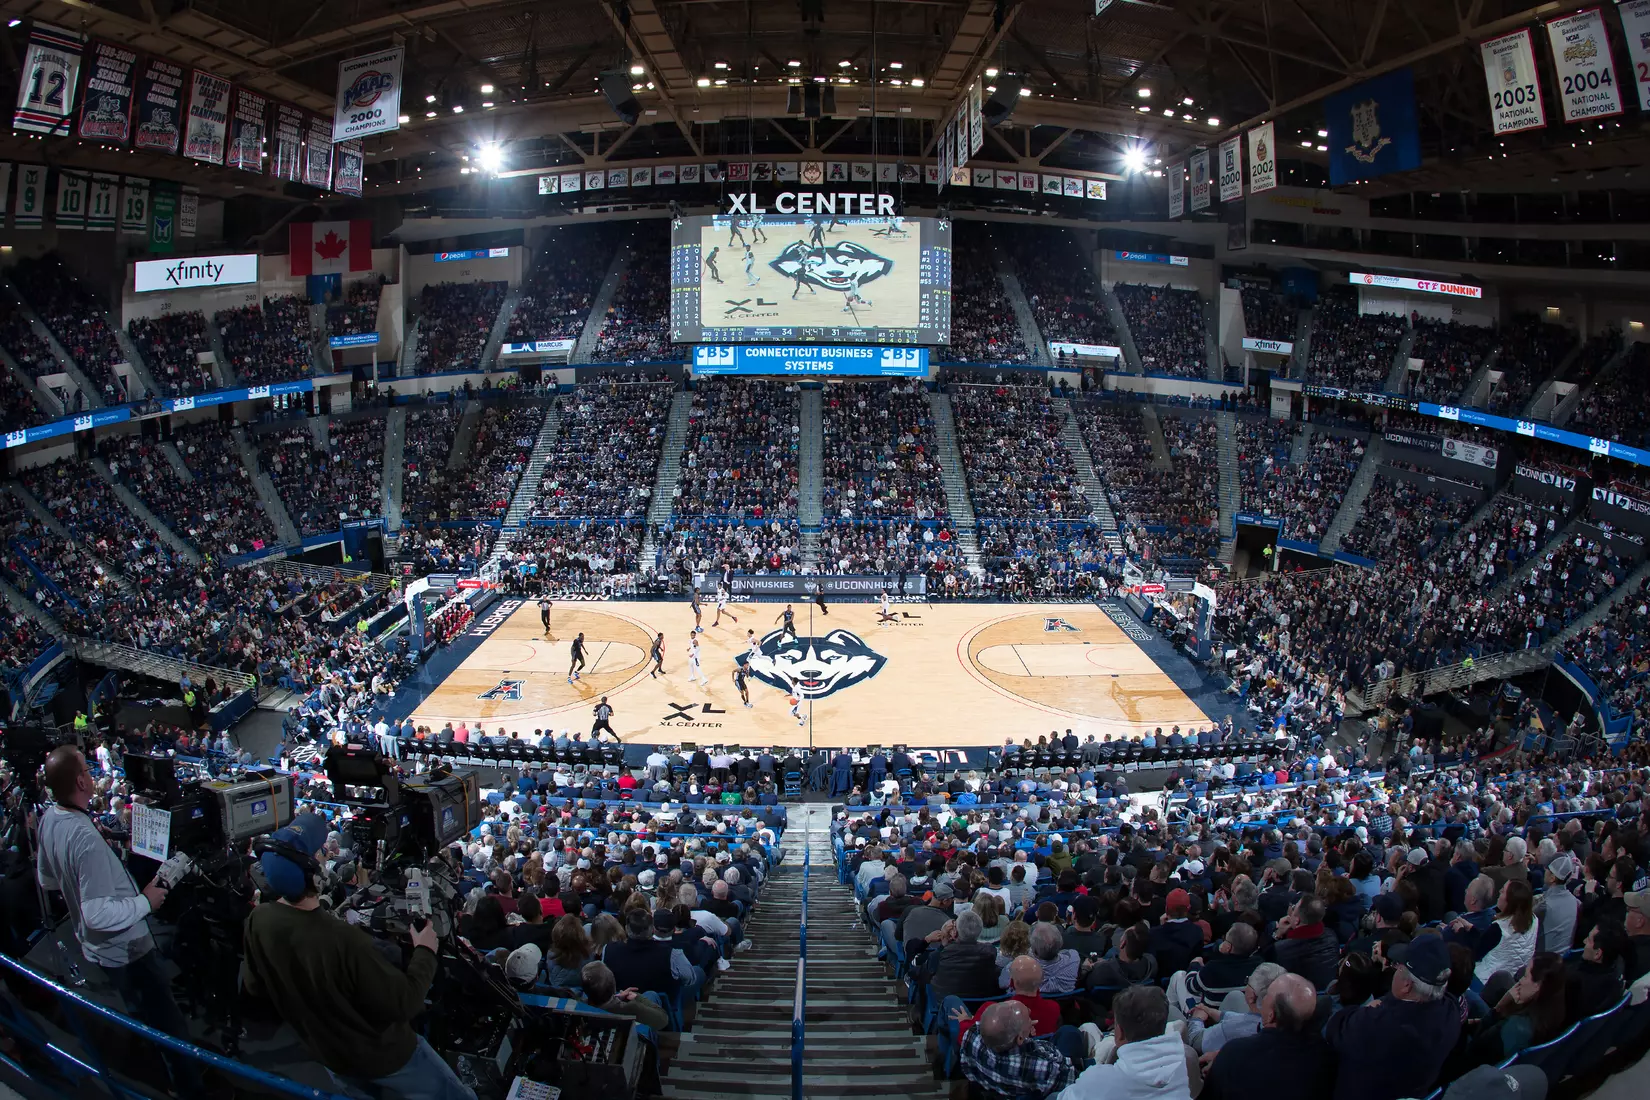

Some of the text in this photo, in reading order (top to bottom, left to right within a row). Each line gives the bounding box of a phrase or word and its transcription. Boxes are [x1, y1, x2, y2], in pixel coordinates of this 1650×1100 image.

[1552, 12, 1597, 29] UConn Women's
[1562, 23, 1590, 35] Basketball
[1484, 33, 1524, 48] UConn Women's
[1566, 34, 1579, 42] NCAA
[96, 44, 136, 63] 1999-2000
[1493, 43, 1519, 54] Basketball
[344, 54, 398, 72] UCONN HOCKEY
[96, 68, 128, 84] SEASON
[1564, 68, 1612, 95] 2004
[30, 67, 67, 108] 12
[88, 78, 132, 98] CHAMPIONS
[342, 72, 394, 113] MAAC
[146, 93, 178, 108] CHAMPIONS
[1494, 84, 1535, 110] 2003
[1572, 92, 1610, 105] NATIONAL
[191, 105, 226, 124] CHAMPIONS
[350, 109, 382, 124] 2000
[1500, 106, 1534, 119] NATIONAL
[1570, 103, 1615, 118] CHAMPIONS
[345, 119, 386, 133] CHAMPIONS
[1498, 117, 1538, 130] CHAMPIONS
[1252, 160, 1273, 177] 2002
[1221, 171, 1240, 186] 2000
[1254, 175, 1272, 184] NATIONAL
[1193, 183, 1208, 196] 1999
[1253, 182, 1274, 192] CHAMPIONS
[24, 187, 36, 212] 9
[62, 190, 81, 212] 10
[94, 193, 110, 214] 11
[728, 192, 895, 215] XL CENTER
[126, 198, 145, 220] 19
[166, 260, 224, 285] xfinity
[1418, 281, 1478, 296] CT DUNKIN'
[161, 302, 172, 311] 239
[724, 298, 778, 314] XL
[1255, 340, 1281, 350] xfinity
[746, 348, 873, 358] CONNECTICUT BUSINESS
[881, 348, 915, 360] CBS
[784, 361, 834, 371] SYSTEMS
[248, 386, 268, 394] CBS
[1517, 420, 1534, 430] CBS
[1385, 433, 1411, 445] UCONN
[1590, 437, 1607, 448] CBS
[1515, 465, 1542, 483] UCONN
[826, 581, 913, 589] @UCONNHUSKES
[469, 600, 522, 636] HUSKIES
[1043, 618, 1082, 632] A
[1099, 604, 1153, 640] HUSKIES
[476, 679, 527, 700] A
[663, 702, 726, 721] XL
